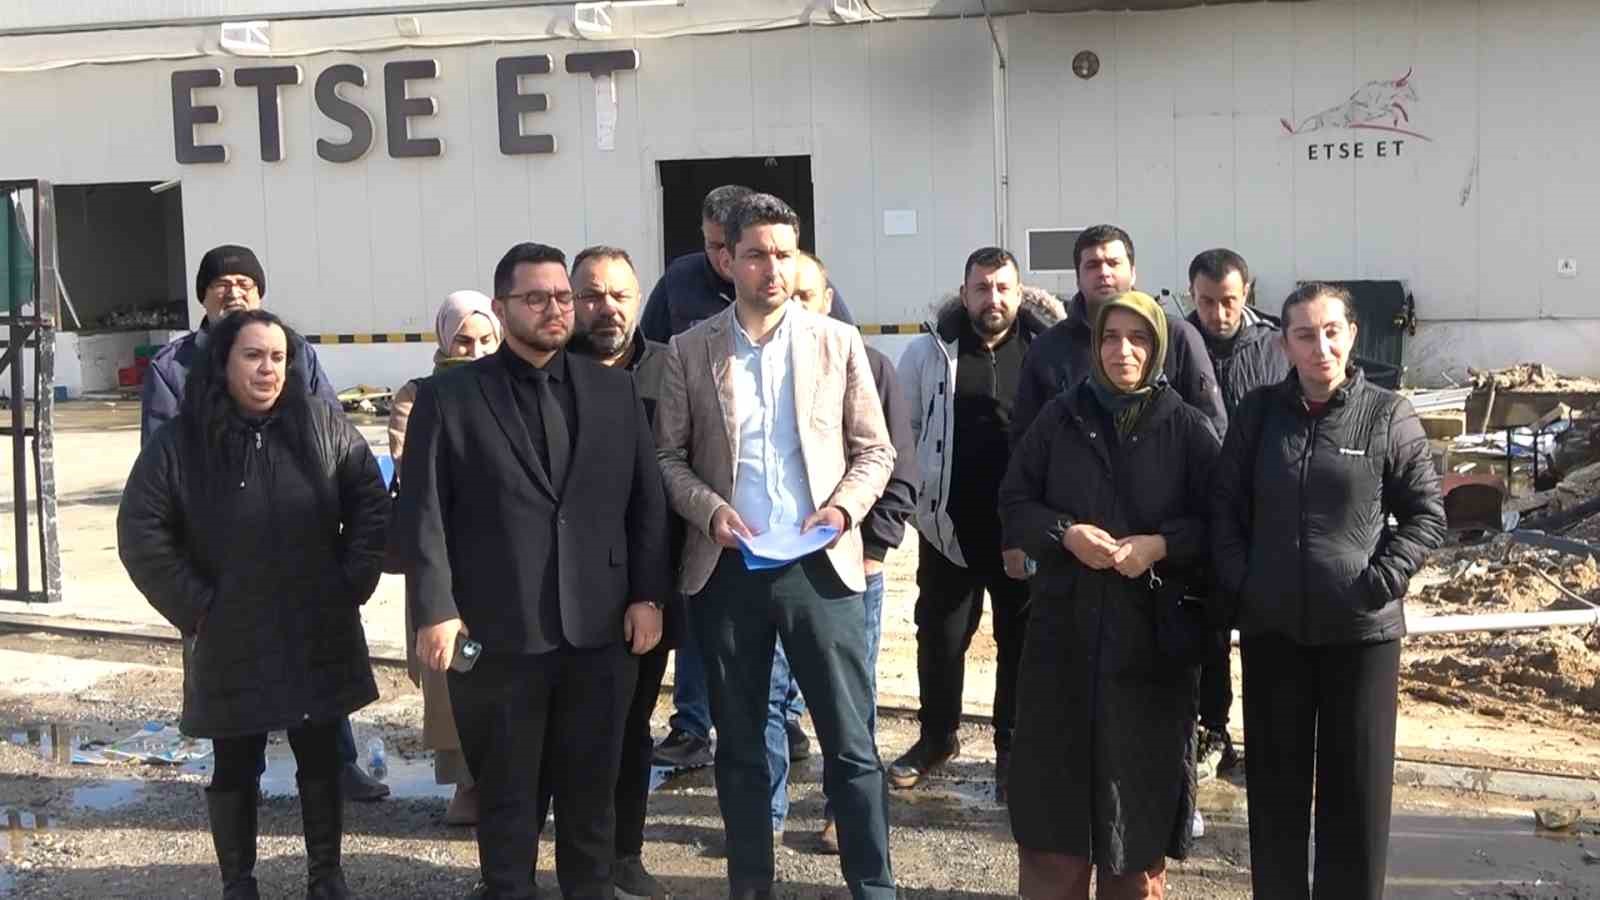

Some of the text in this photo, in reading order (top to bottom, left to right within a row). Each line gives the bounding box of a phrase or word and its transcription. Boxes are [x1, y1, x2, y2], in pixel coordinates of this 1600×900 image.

[171, 48, 640, 164] ETSE ET
[1308, 139, 1405, 161] ETSE ET
